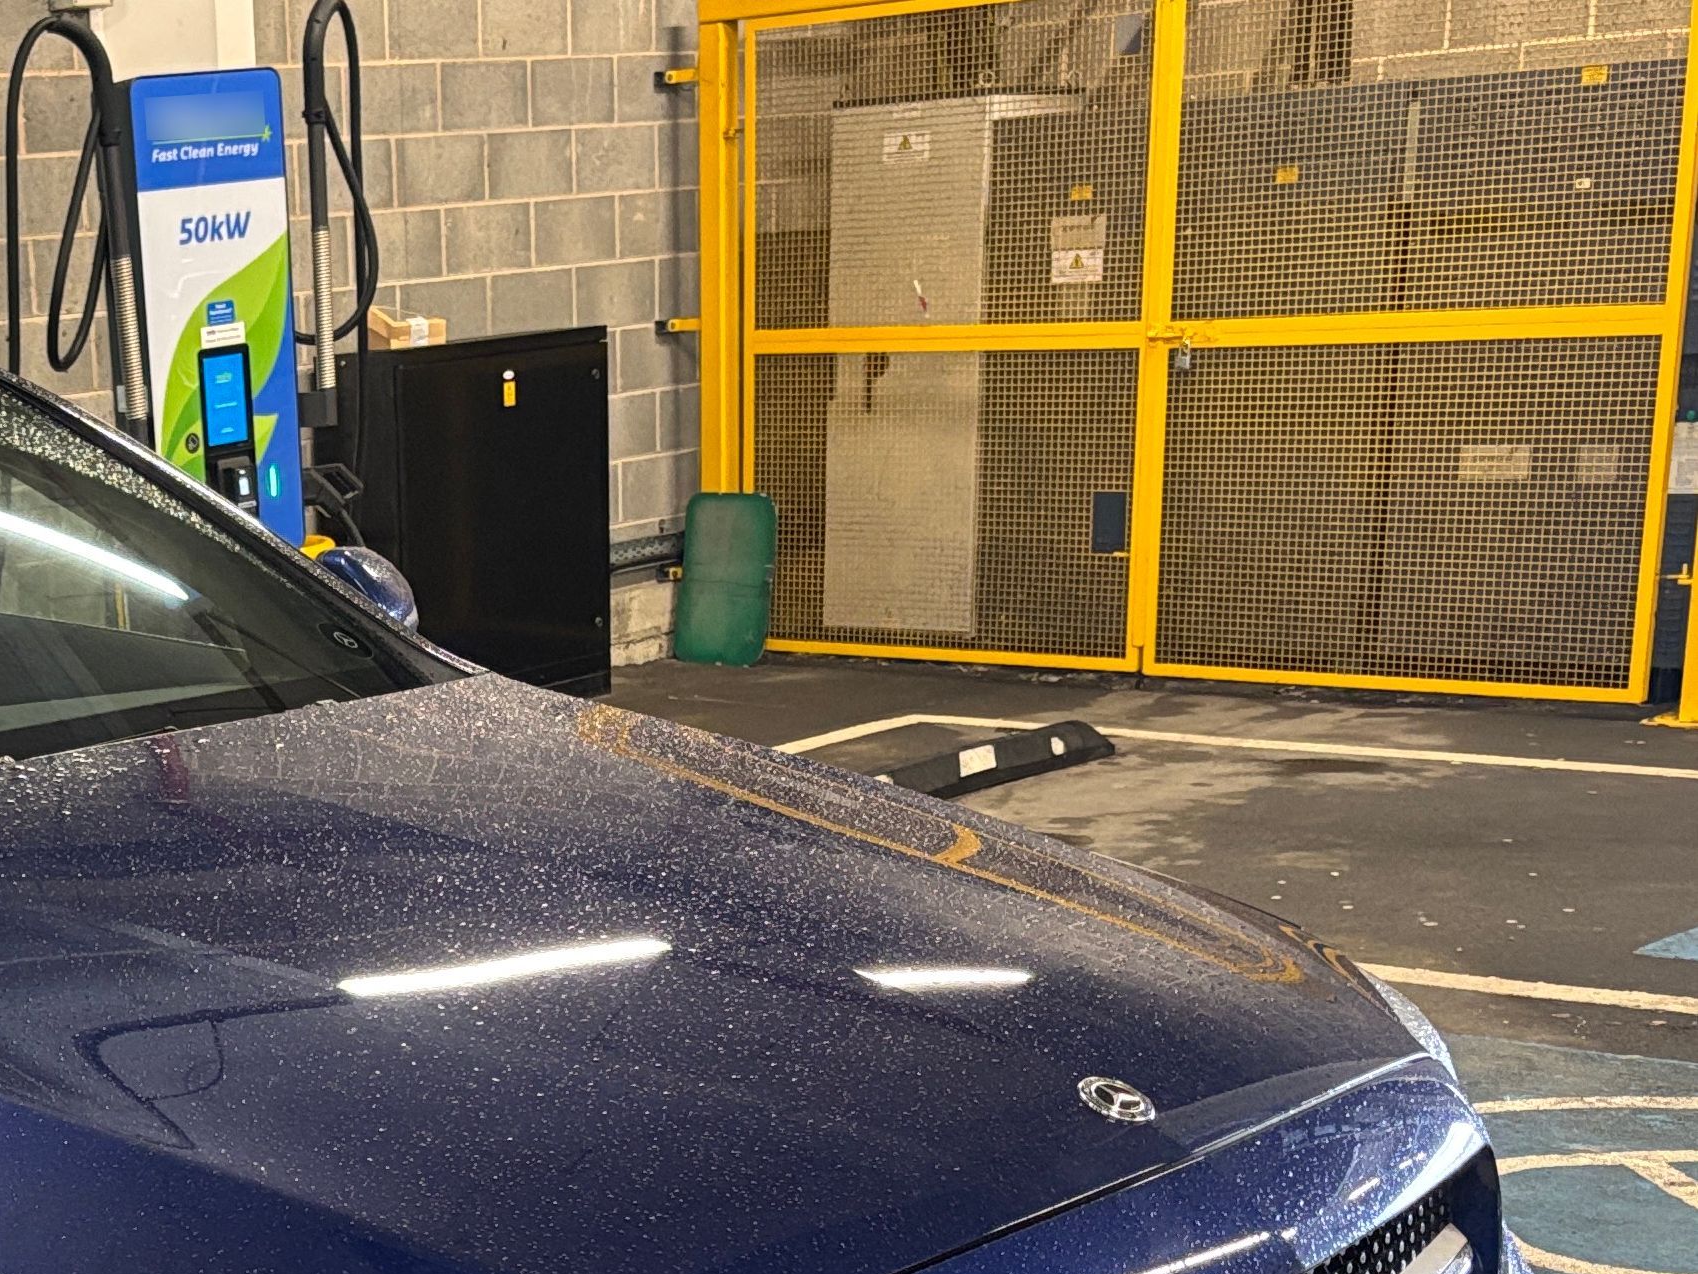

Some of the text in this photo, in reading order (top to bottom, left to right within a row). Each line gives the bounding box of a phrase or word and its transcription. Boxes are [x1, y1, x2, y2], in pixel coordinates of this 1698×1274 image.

[152, 142, 260, 163] Fast Clean Energy
[179, 211, 252, 246] 50kW
